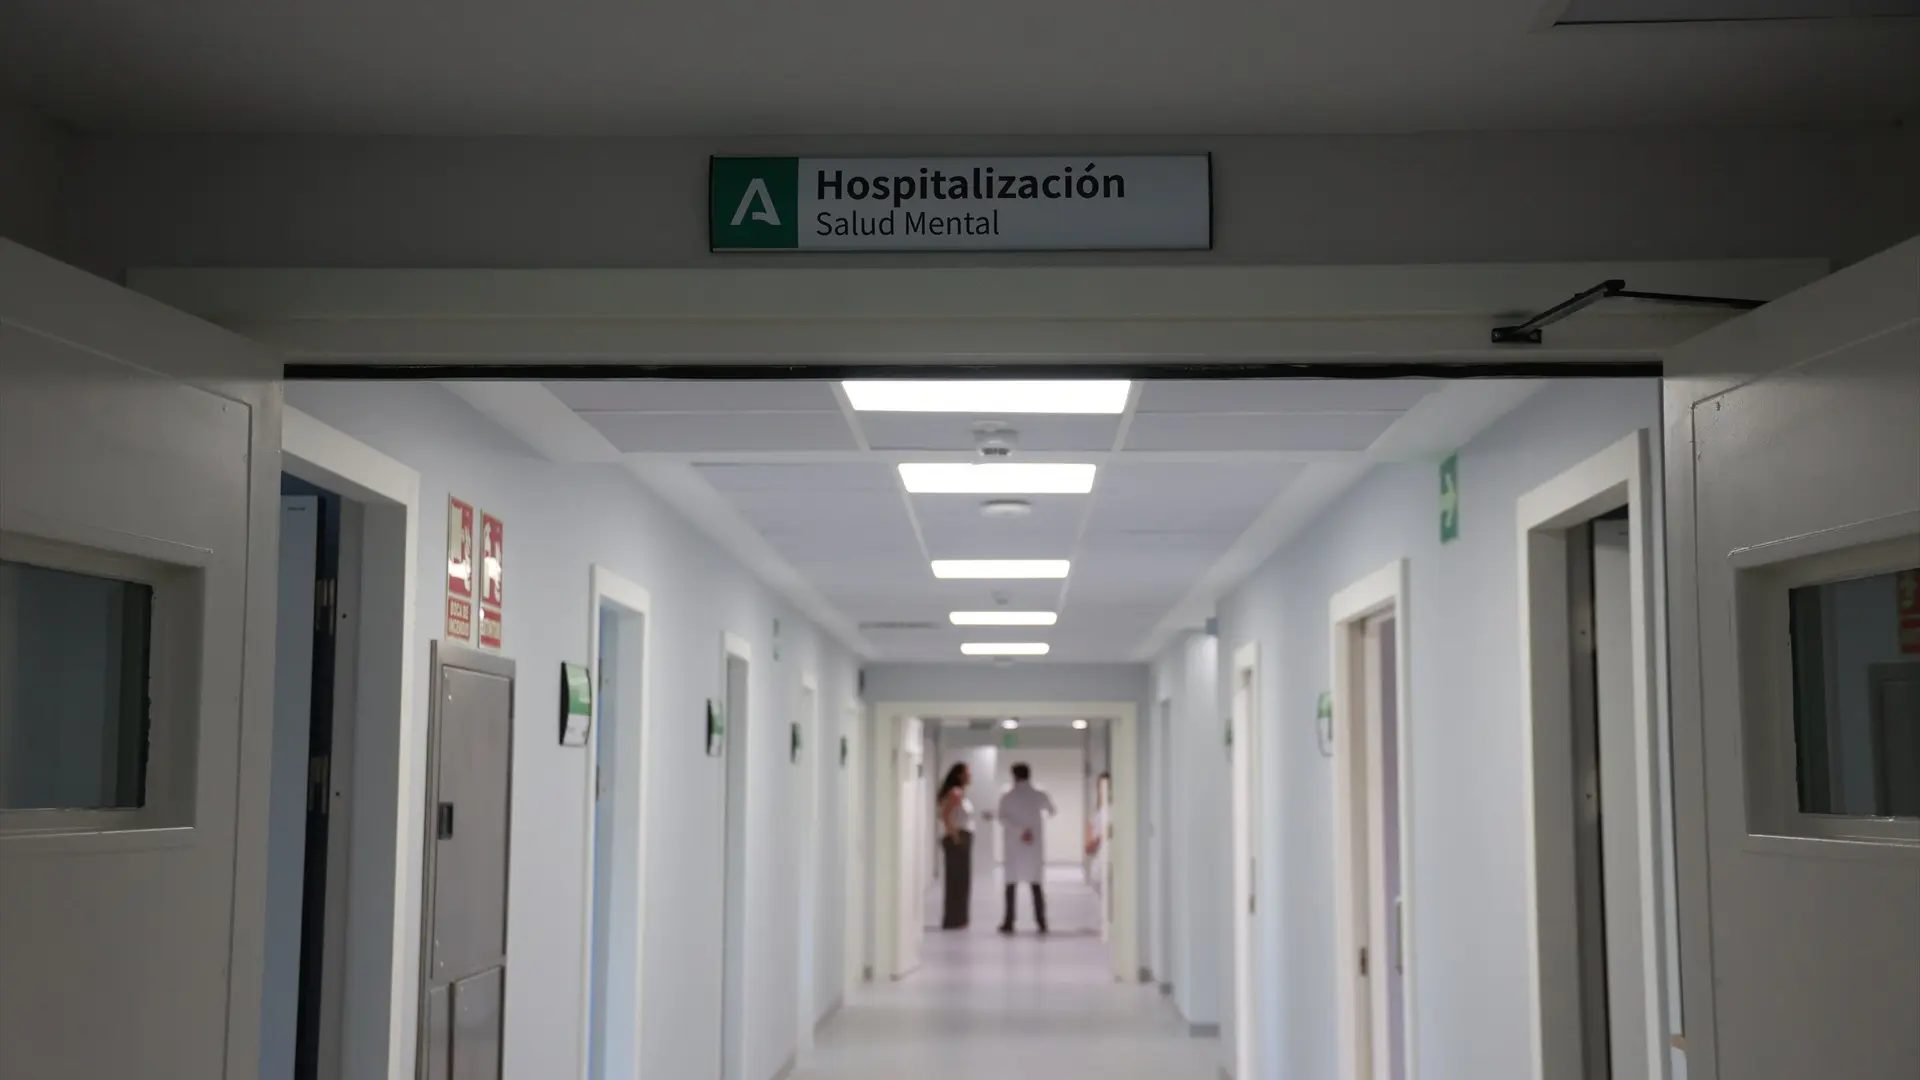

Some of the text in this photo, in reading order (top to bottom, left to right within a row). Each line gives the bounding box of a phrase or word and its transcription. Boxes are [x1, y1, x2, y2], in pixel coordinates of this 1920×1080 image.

[816, 163, 1125, 207] Hospitalización
[816, 210, 999, 236] Salud Mental
